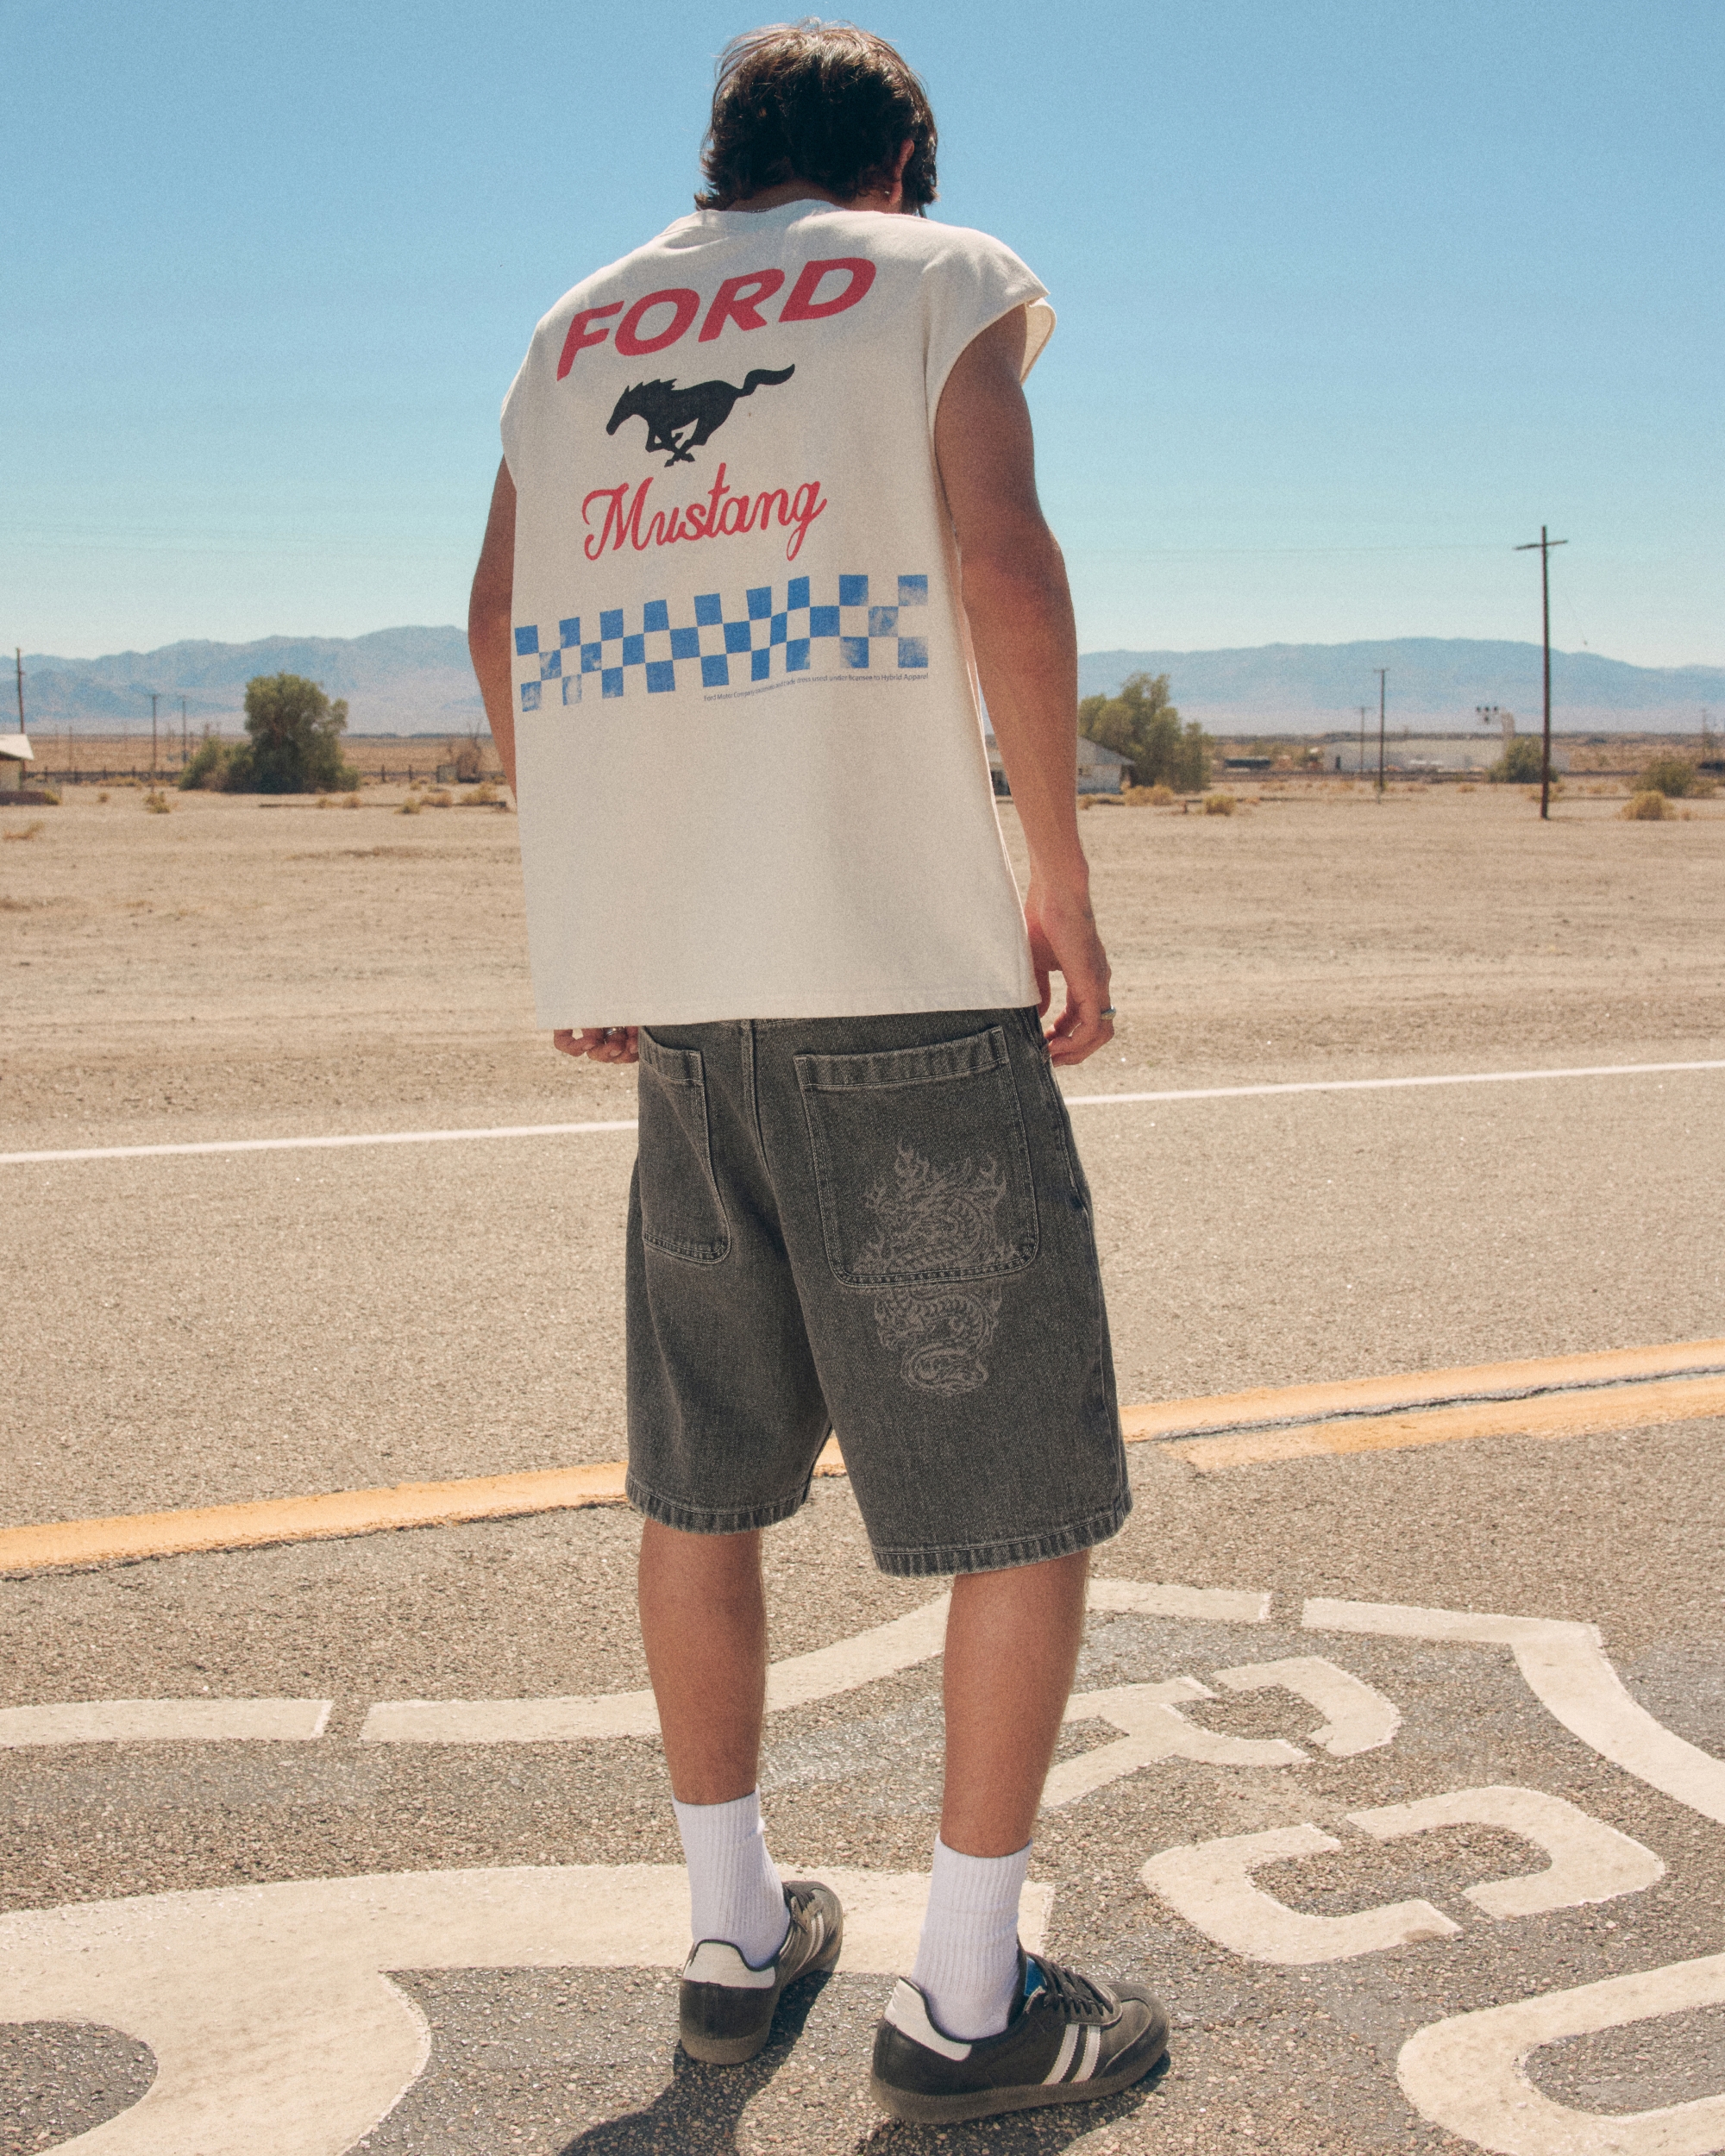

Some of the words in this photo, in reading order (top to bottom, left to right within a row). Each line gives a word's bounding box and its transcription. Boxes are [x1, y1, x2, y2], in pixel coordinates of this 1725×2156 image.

[557, 258, 875, 379] FORD
[582, 463, 826, 561] Mustang
[903, 673, 929, 681] Apparel
